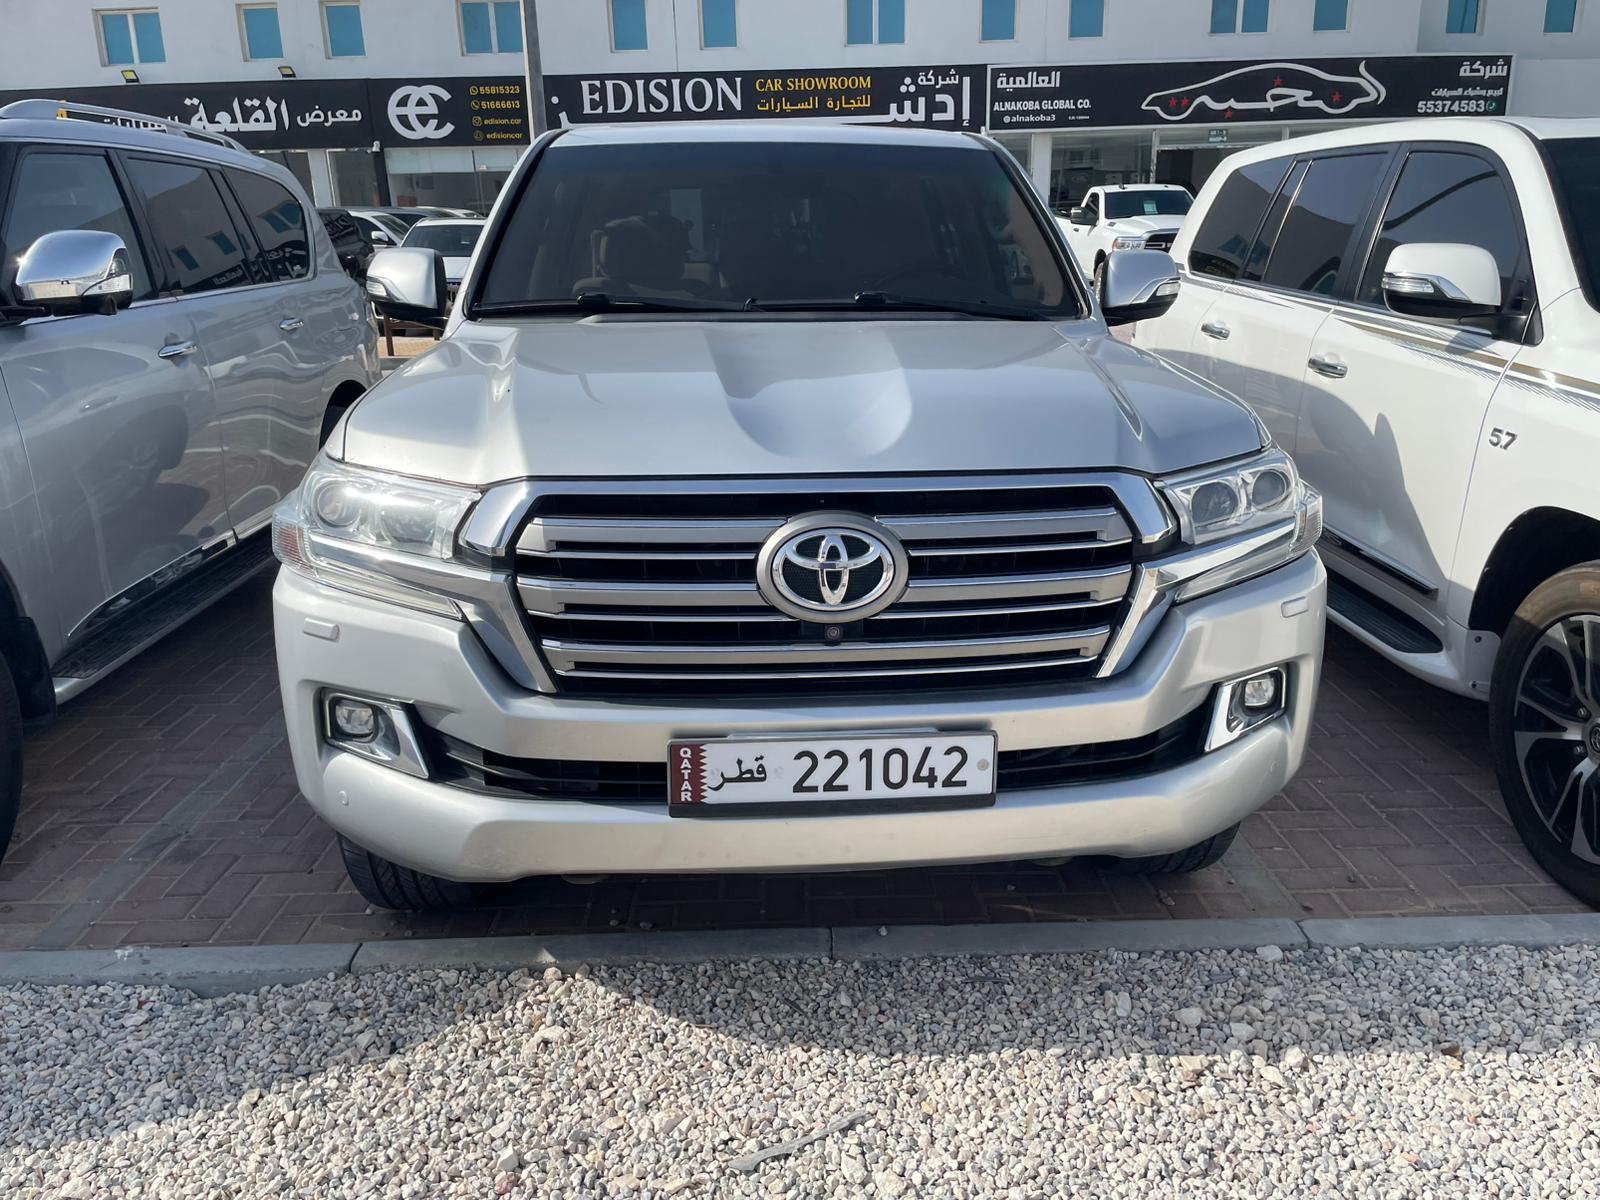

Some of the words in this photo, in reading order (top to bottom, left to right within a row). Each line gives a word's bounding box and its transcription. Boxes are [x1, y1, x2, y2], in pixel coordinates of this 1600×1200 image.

[918, 68, 959, 88] شركة
[1459, 59, 1508, 79] شركة
[755, 79, 782, 92] CAR
[787, 76, 871, 91] SHOWROOM
[996, 71, 1061, 92] العالمية
[580, 77, 743, 115] EDISION
[757, 97, 818, 112] السيارات
[826, 95, 871, 111] للتجارة
[993, 101, 1040, 112] ALNAKOBA
[1041, 100, 1076, 110] GLOBAL
[1077, 99, 1091, 109] CO.
[184, 96, 290, 132] القلعة
[296, 105, 362, 127] معرض
[1417, 100, 1485, 113] 55374583
[1003, 114, 1056, 124] @alnakoba3
[678, 747, 692, 802] QATAR
[707, 755, 767, 791] قطر
[792, 746, 968, 793] 221042
